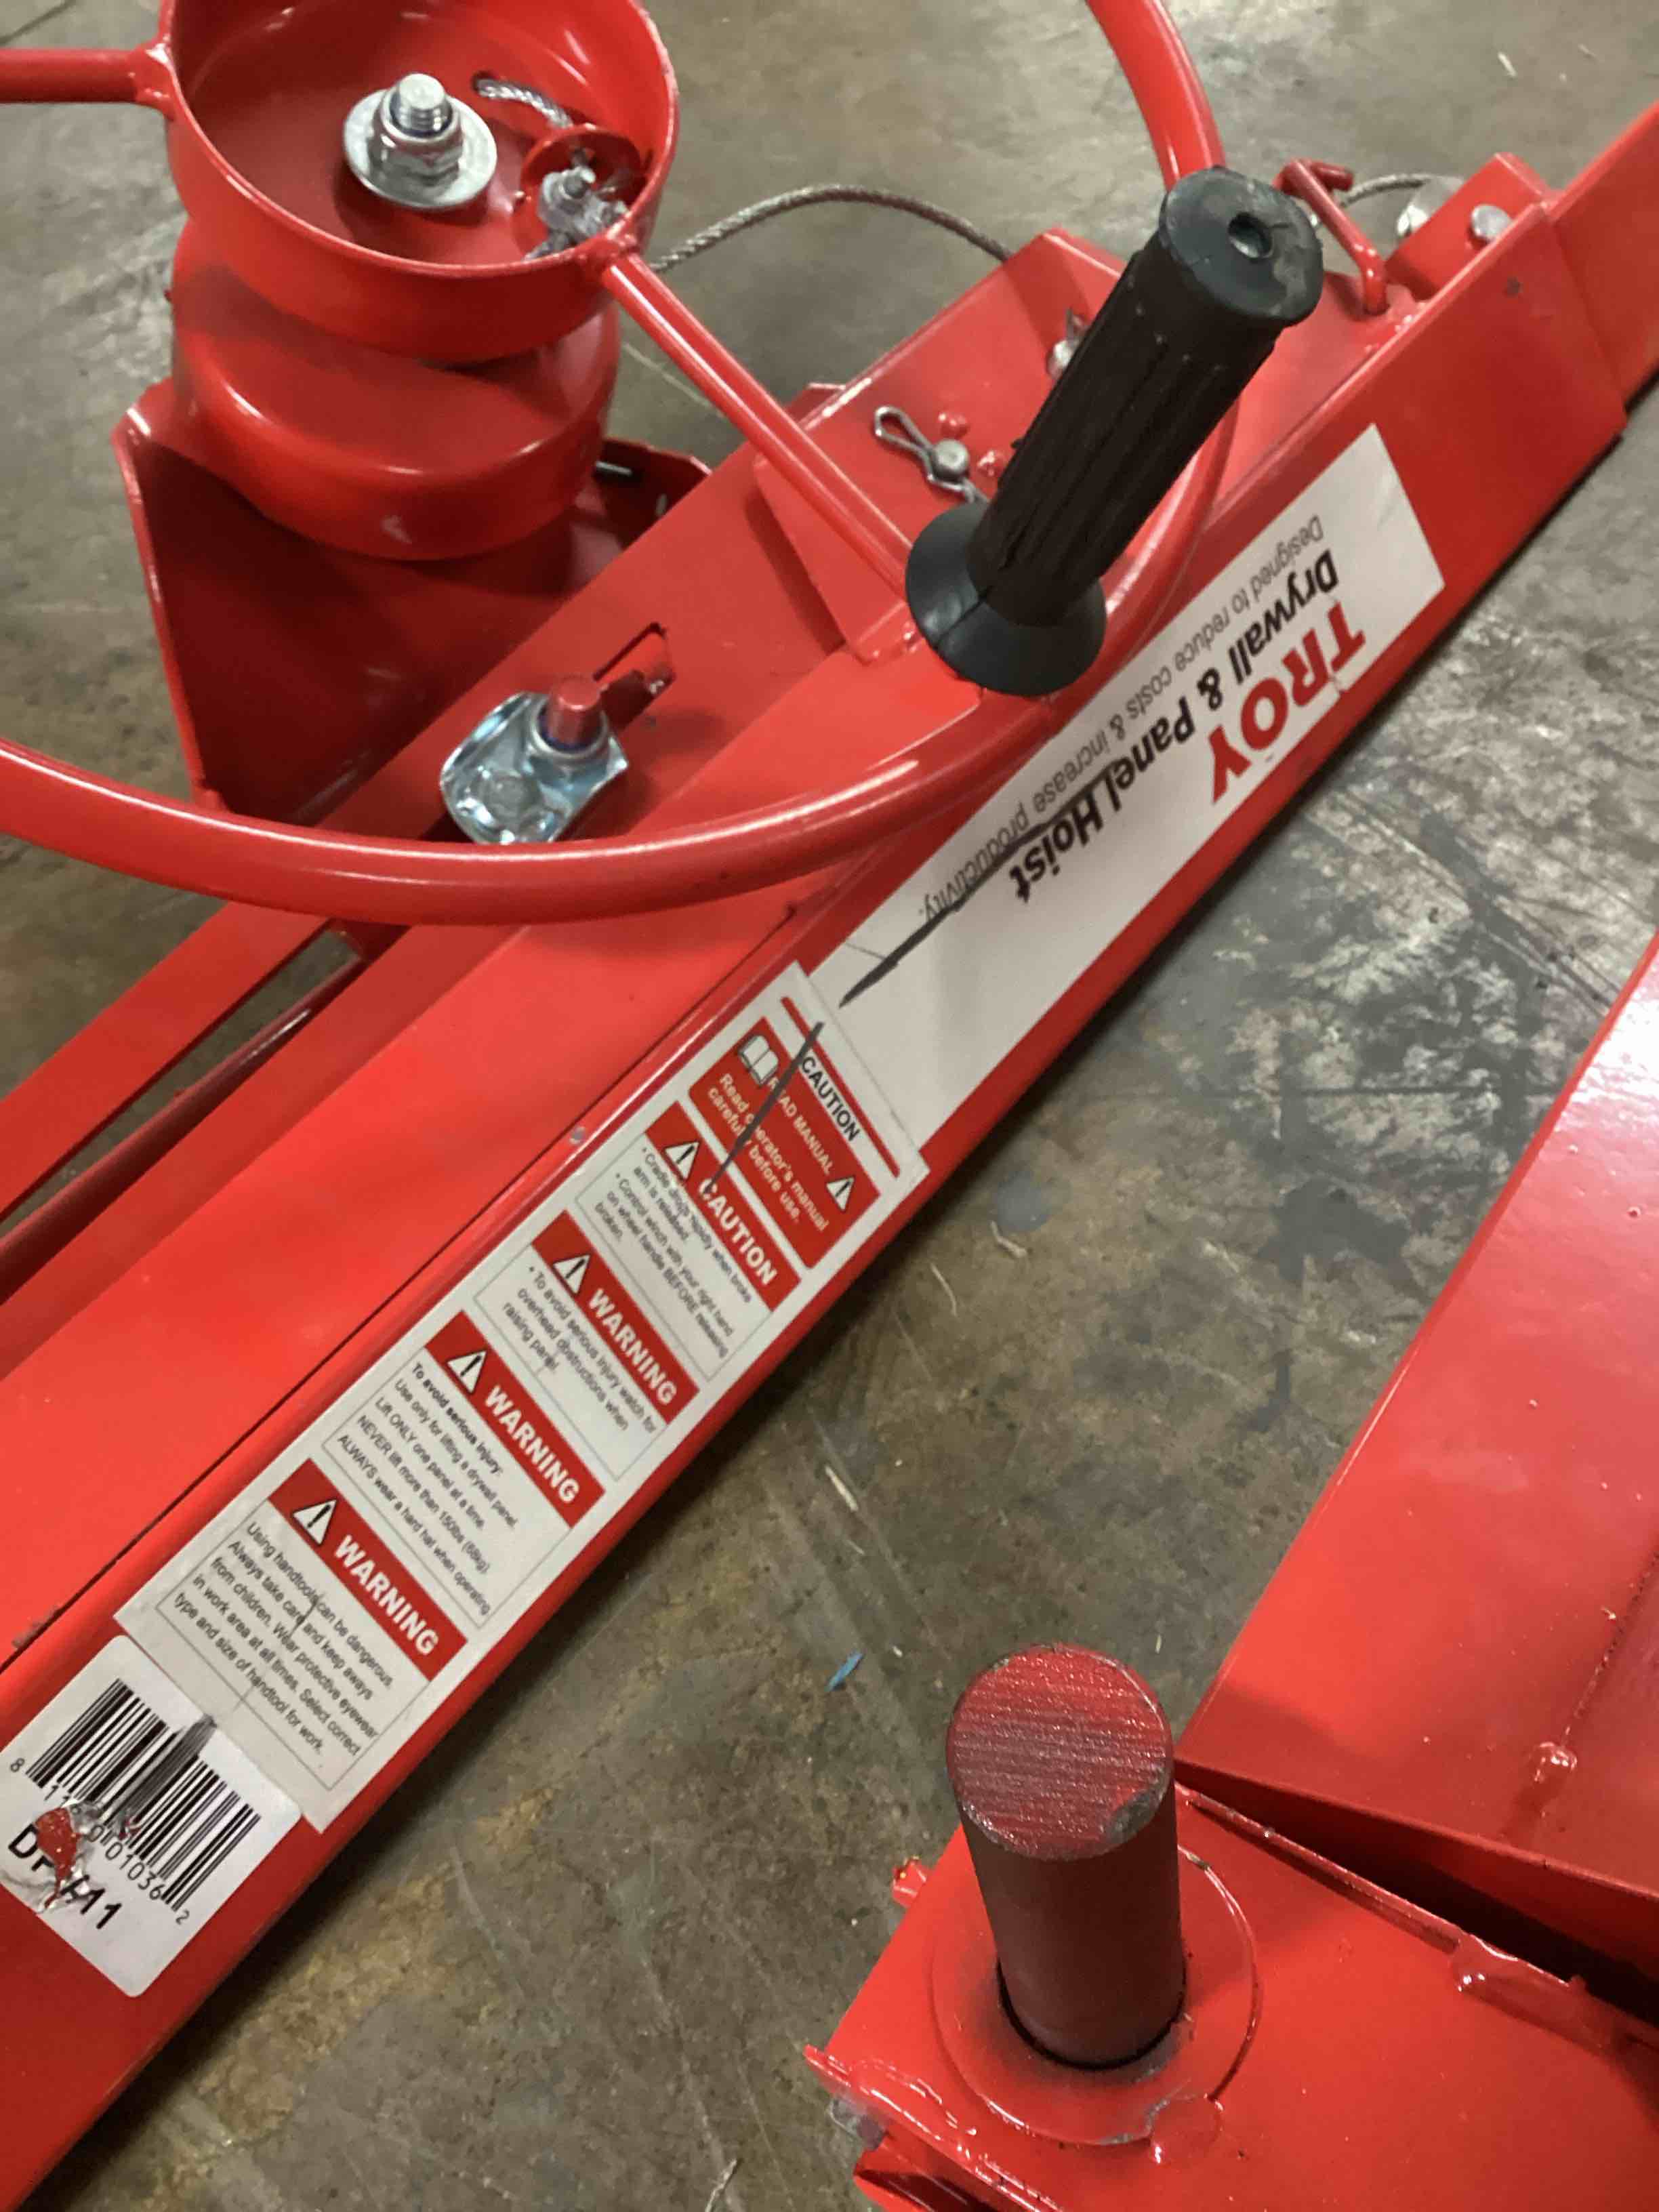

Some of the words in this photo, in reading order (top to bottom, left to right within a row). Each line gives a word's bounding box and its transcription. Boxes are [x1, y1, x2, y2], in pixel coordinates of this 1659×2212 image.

[1229, 587, 1251, 617] to
[1247, 512, 1325, 602] Designed
[1171, 606, 1231, 674] reduce
[1224, 546, 1340, 685] Drywall
[1107, 712, 1127, 741] &
[1123, 664, 1174, 722] costs
[1195, 665, 1226, 712] &
[1200, 600, 1366, 801] TROY
[1031, 729, 1109, 815] increase
[1095, 695, 1197, 813] Panel
[1006, 790, 1105, 903] Hoist
[718, 1072, 750, 1113] Read
[743, 1111, 794, 1183] oerator's
[790, 1180, 829, 1231] manual
[766, 1076, 798, 1118] RAD
[792, 1115, 834, 1174] MANUAL
[799, 1054, 860, 1141] CAUTION
[632, 1166, 651, 1187] arm
[697, 1176, 777, 1286] CAUTION
[747, 1144, 782, 1192] before
[779, 1191, 801, 1221] use.
[617, 1177, 649, 1217] Control
[644, 1215, 668, 1247] winch
[665, 1244, 683, 1267] with
[678, 1265, 699, 1290] your
[712, 1309, 734, 1337] hand
[617, 1205, 642, 1236] wheel
[638, 1233, 666, 1271] handle
[662, 1267, 699, 1313] BEFORE
[501, 1301, 535, 1343] raising
[516, 1287, 561, 1340] overhead
[555, 1337, 607, 1402] obstructions
[604, 1399, 629, 1431] when
[542, 1287, 571, 1321] avoid
[566, 1318, 599, 1359] serious
[594, 1355, 621, 1390] injury
[618, 1386, 645, 1418] watch
[588, 1288, 678, 1405] WARNING
[374, 1396, 393, 1417] Lift
[388, 1412, 417, 1444] ONLY
[411, 1442, 431, 1464] one
[426, 1460, 454, 1490] panel
[394, 1378, 414, 1403] Use
[409, 1399, 431, 1425] only
[438, 1432, 464, 1465] lifting
[466, 1467, 497, 1503] drywall
[422, 1377, 450, 1409] avoid
[445, 1406, 478, 1446] serious
[484, 1385, 580, 1504] WARNING
[337, 1433, 378, 1479] ALWAYS
[373, 1477, 397, 1502] wear
[400, 1506, 424, 1533] hard
[419, 1528, 437, 1549] hat
[432, 1545, 457, 1573] when
[356, 1414, 392, 1455] NEVER
[398, 1465, 422, 1492] more
[418, 1488, 441, 1514] than
[437, 1510, 466, 1544] 150lbs
[226, 1540, 265, 1581] Always
[261, 1575, 285, 1603] take
[281, 1599, 307, 1627] care
[302, 1621, 325, 1645] and
[319, 1640, 346, 1671] keep
[341, 1666, 373, 1702] aways
[244, 1521, 277, 1559] Using
[315, 1601, 337, 1624] can
[332, 1618, 350, 1637] be
[333, 1534, 439, 1656] WARNING
[172, 1591, 199, 1620] type
[195, 1615, 220, 1640] and
[214, 1635, 239, 1661] size
[245, 1666, 289, 1714] handtool
[284, 1708, 302, 1728] for
[203, 1586, 230, 1615] work
[226, 1612, 251, 1639] area
[258, 1645, 276, 1664] all
[270, 1657, 301, 1693] times.
[298, 1687, 331, 1724] Select
[326, 1719, 362, 1757] correct
[209, 1555, 237, 1585] from
[232, 1581, 273, 1627] children.
[271, 1621, 300, 1654] Wear
[293, 1650, 342, 1702] protective
[337, 1697, 379, 1740] eyewear
[9, 1757, 26, 1774] 8
[104, 1839, 163, 1902] 01036
[175, 1908, 191, 1925] 2
